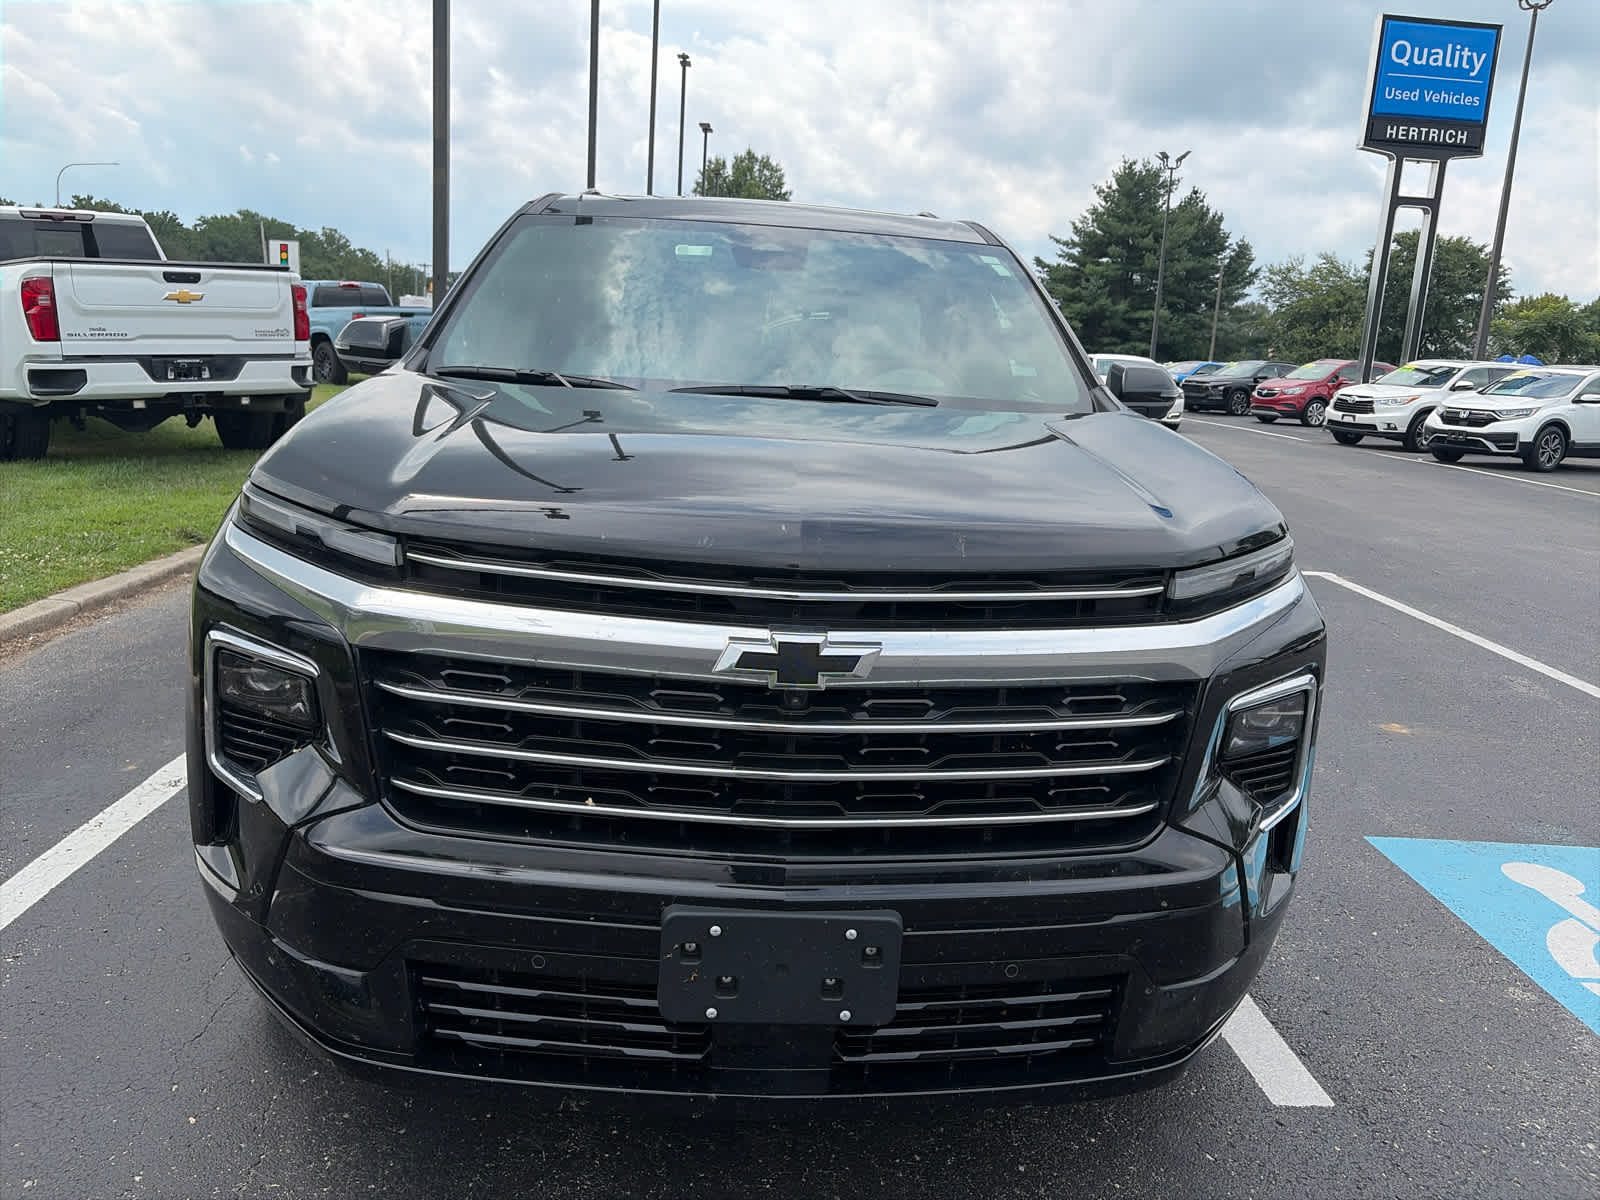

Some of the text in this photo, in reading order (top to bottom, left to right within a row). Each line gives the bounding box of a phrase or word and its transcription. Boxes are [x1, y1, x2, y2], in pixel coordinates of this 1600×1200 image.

[1391, 40, 1487, 77] Quality
[1385, 87, 1480, 106] Used Vehicles
[1386, 125, 1468, 144] HERTRICH
